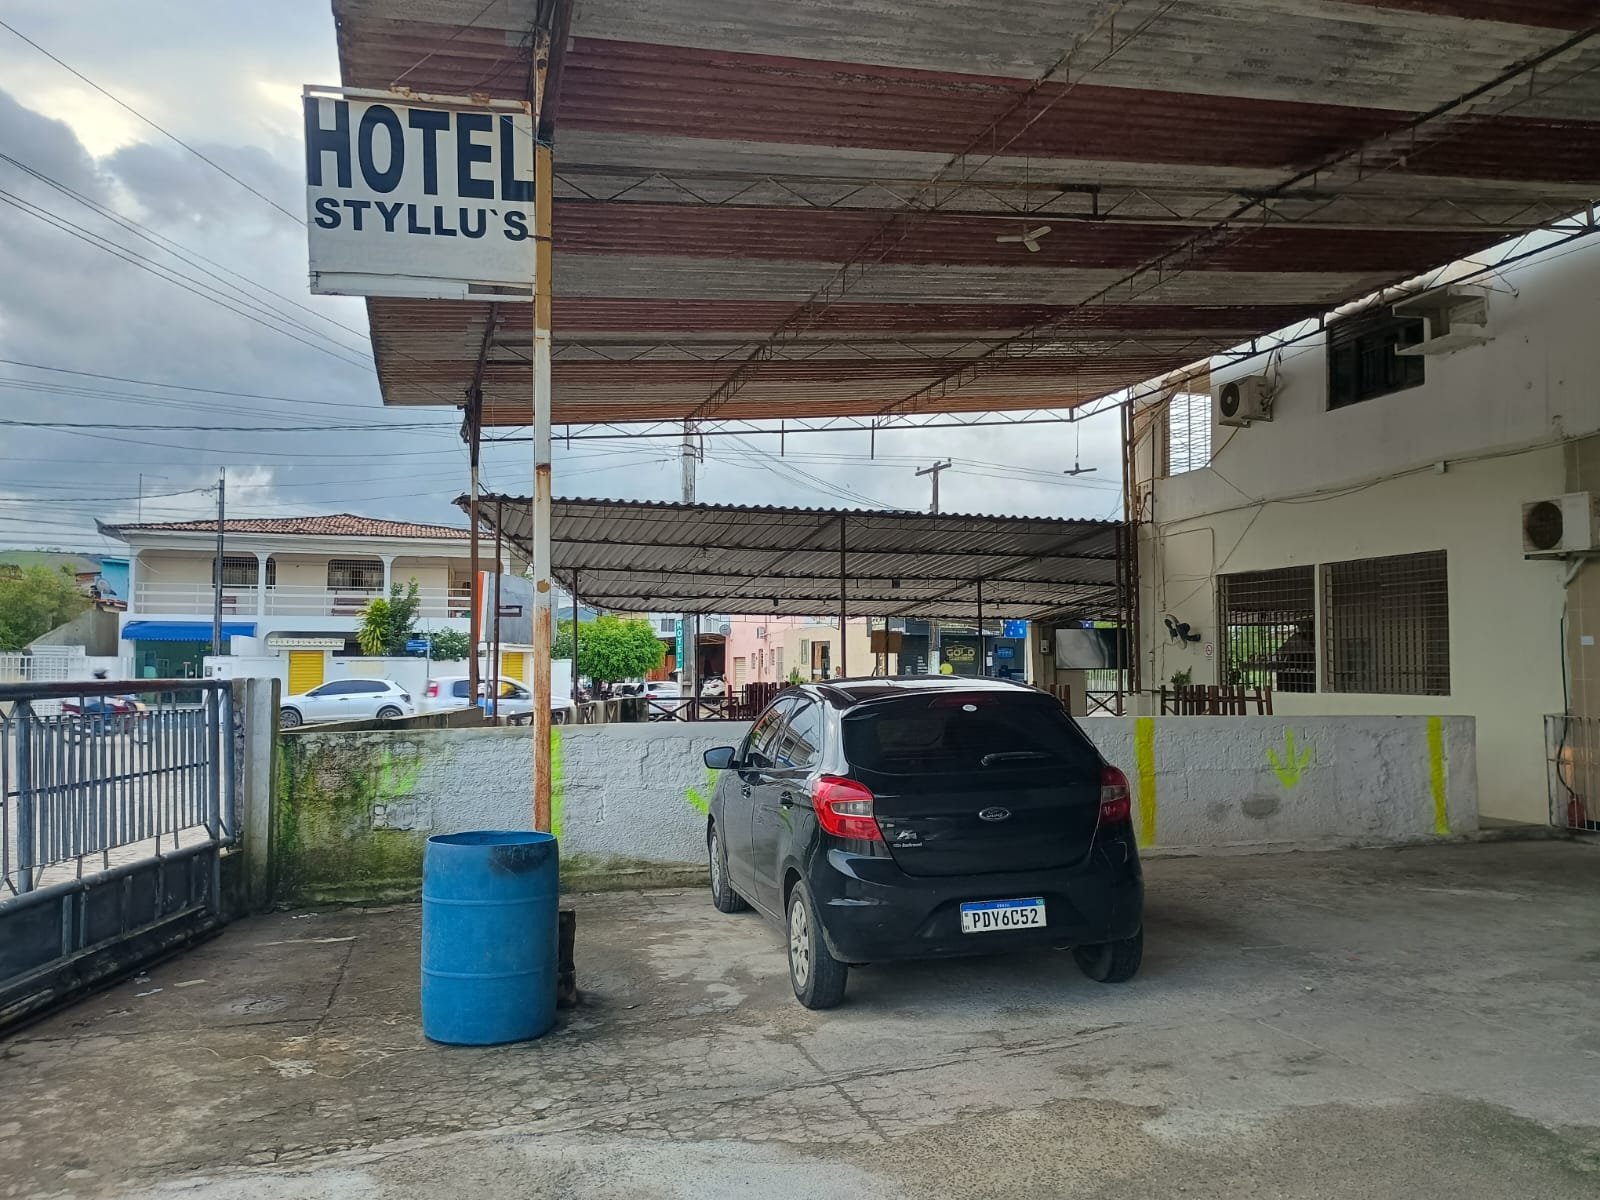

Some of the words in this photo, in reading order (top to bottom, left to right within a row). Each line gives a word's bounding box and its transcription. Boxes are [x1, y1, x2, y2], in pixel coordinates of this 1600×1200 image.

[304, 97, 535, 202] HOTEL
[946, 648, 976, 657] GOLD
[972, 908, 1039, 928] PDY6C52
